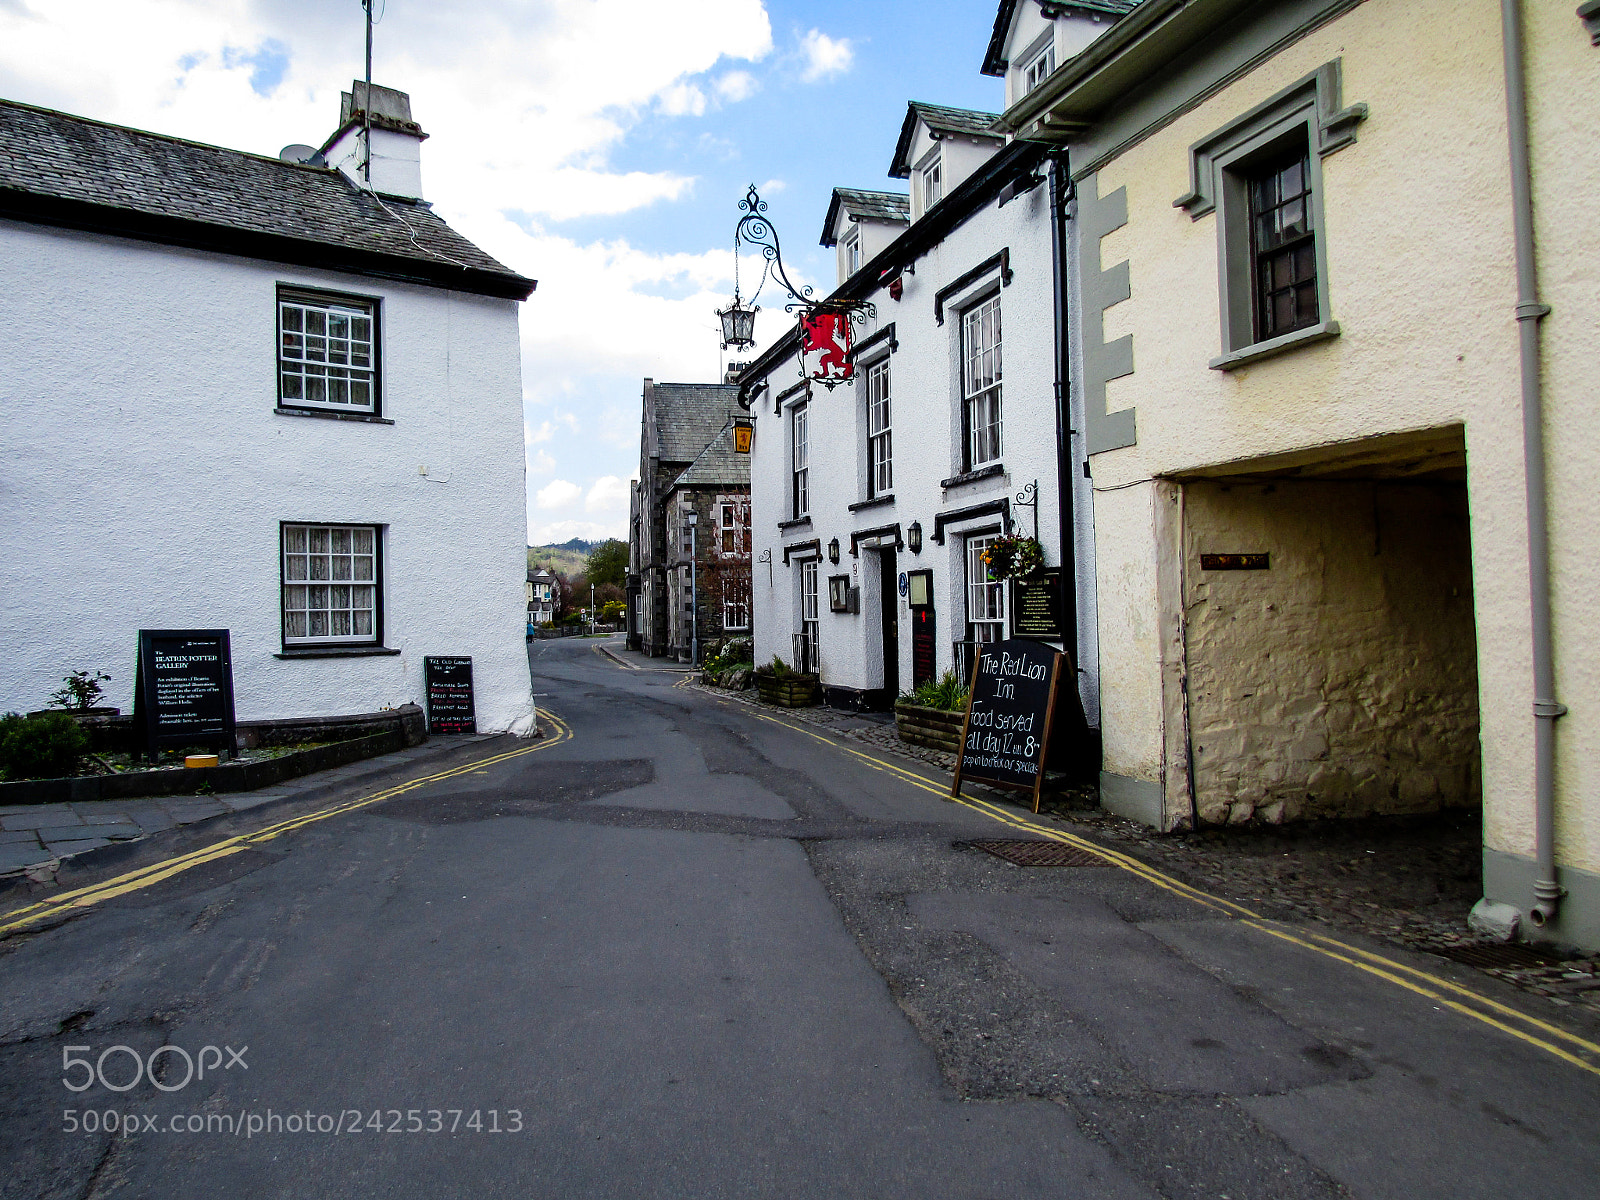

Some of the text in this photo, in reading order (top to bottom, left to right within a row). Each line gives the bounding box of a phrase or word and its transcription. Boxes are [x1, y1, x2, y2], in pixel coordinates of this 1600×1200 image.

[981, 651, 1047, 681] The Red Lion
[971, 701, 1035, 732] Food served
[966, 731, 981, 750] all
[983, 731, 1001, 759] day
[1003, 732, 1014, 754] 12
[962, 755, 975, 768] pop
